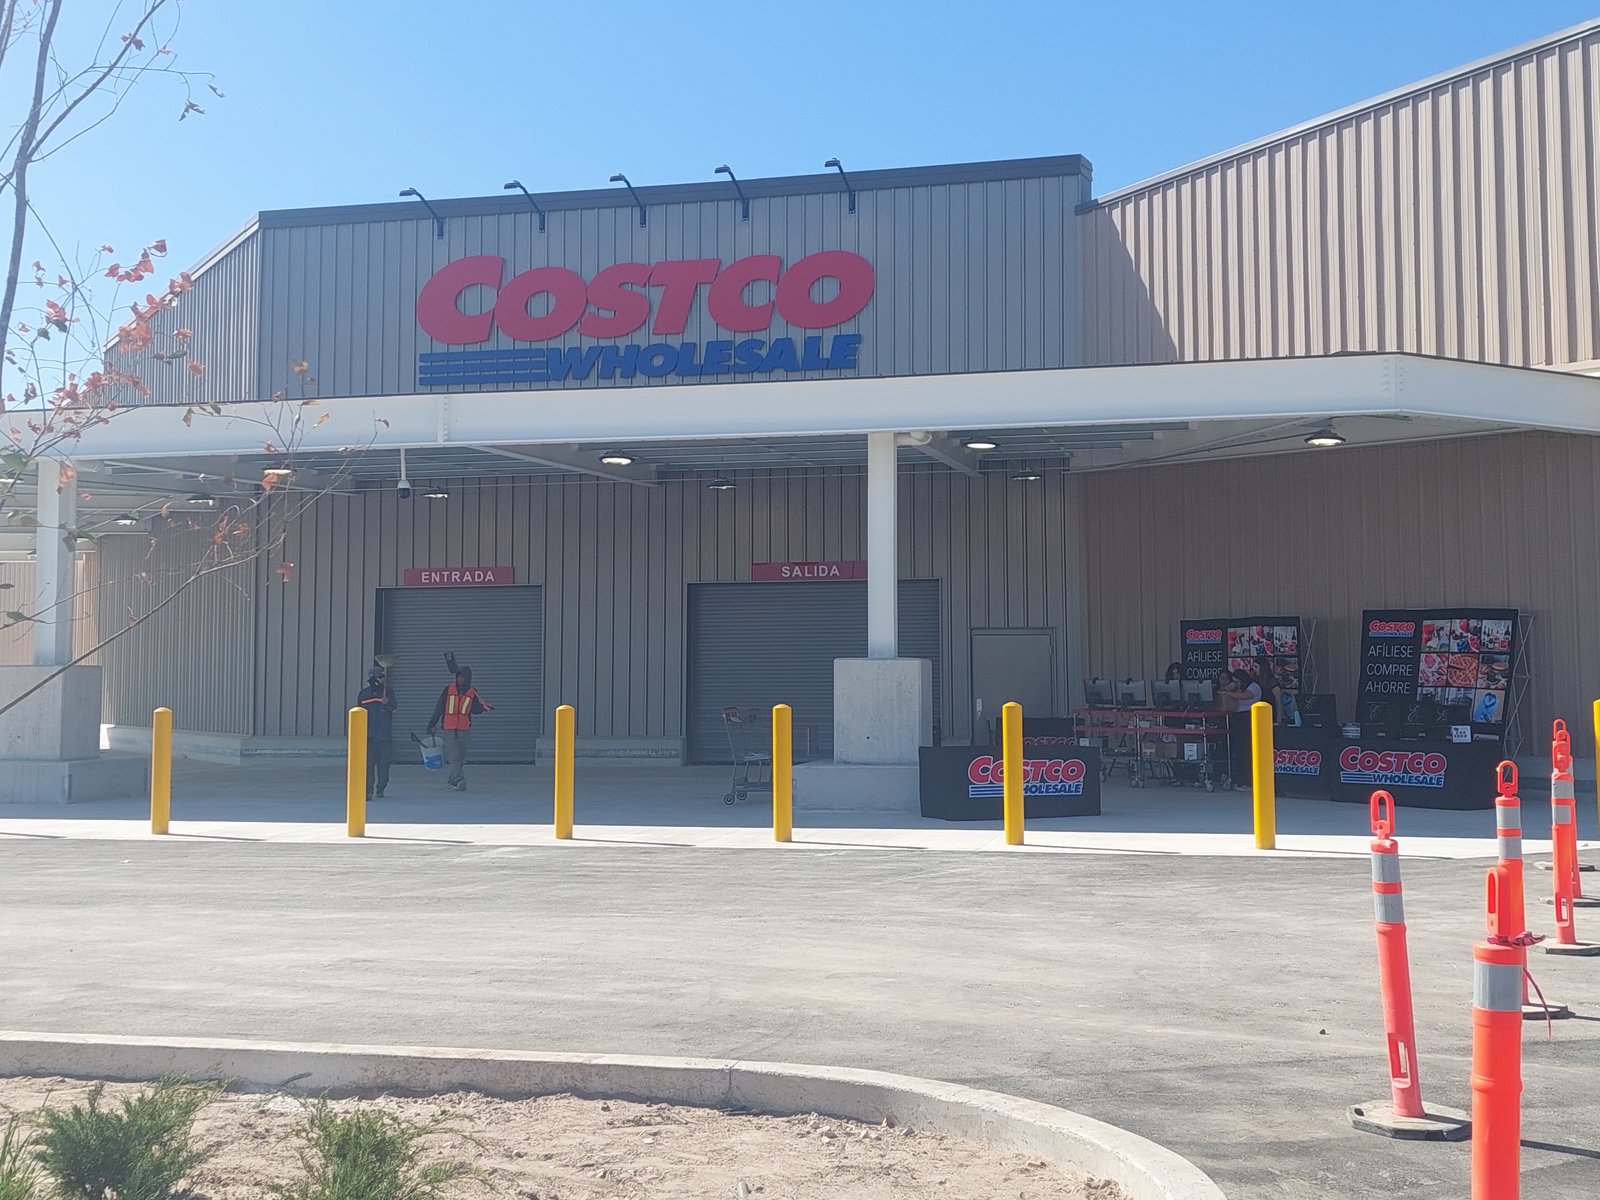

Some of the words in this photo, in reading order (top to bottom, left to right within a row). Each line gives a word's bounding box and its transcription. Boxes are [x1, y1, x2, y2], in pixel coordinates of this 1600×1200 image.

[416, 250, 875, 345] COSTCO
[546, 334, 862, 381] WHOLESALE
[421, 570, 496, 583] ENTRADA
[781, 565, 841, 578] SALIDA
[1369, 620, 1416, 633] COSTCO
[1368, 643, 1414, 658] AFÍLIESE
[1366, 663, 1413, 677] COMPRE
[1365, 680, 1411, 694] AHORRE
[1340, 746, 1447, 775] COSTCO
[1372, 773, 1444, 787] WHOLESALE
[1023, 783, 1083, 795] HOLESALE
